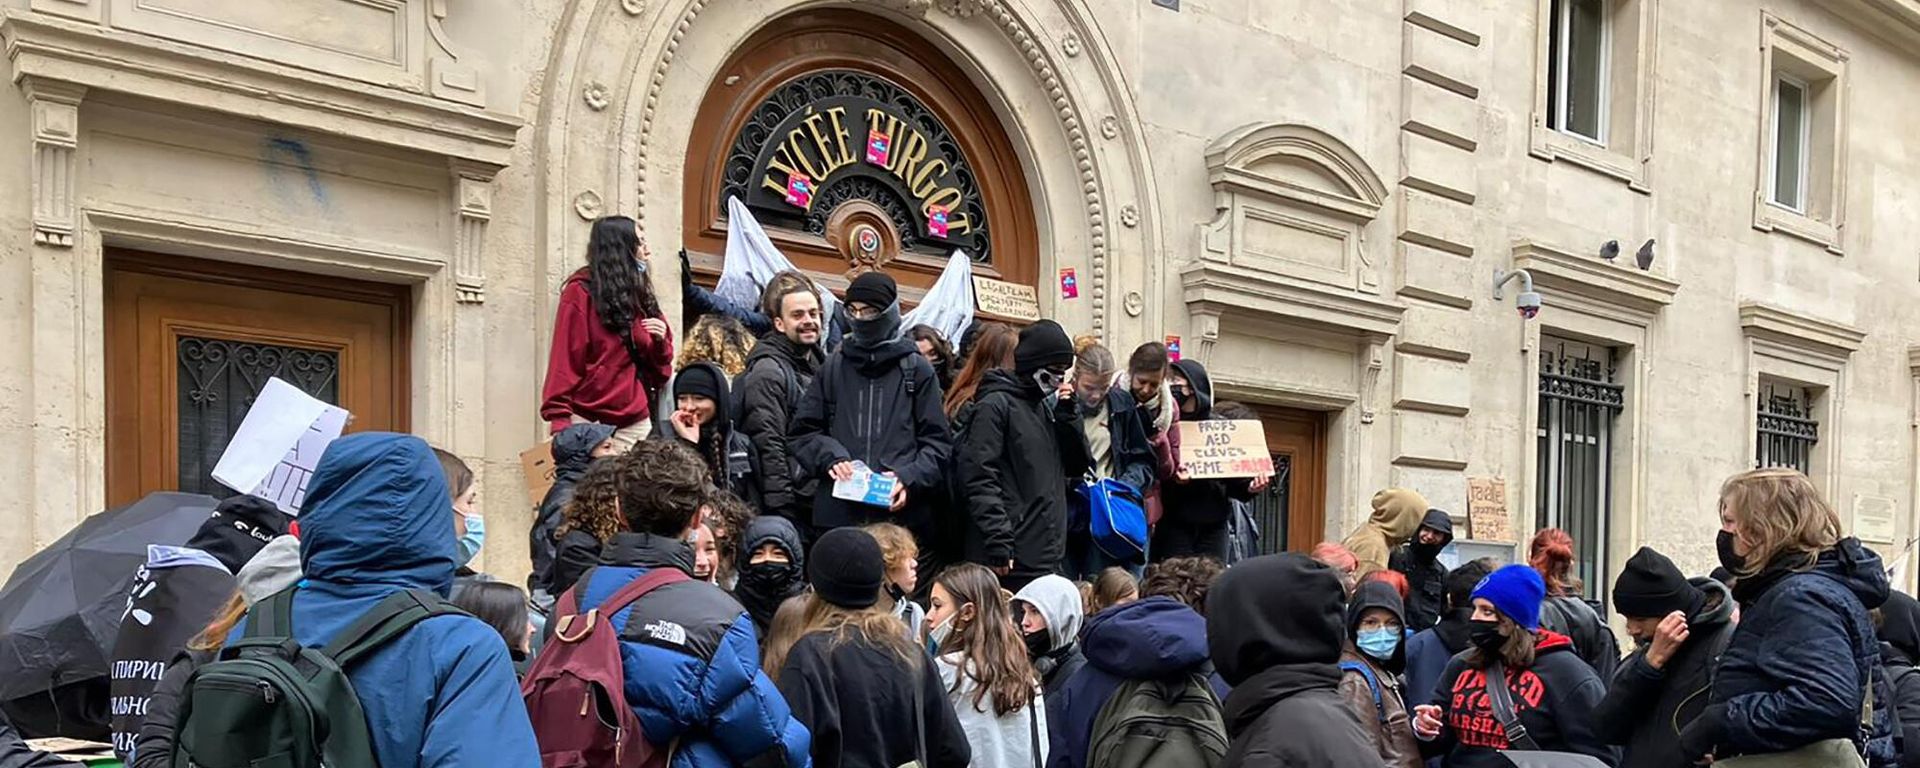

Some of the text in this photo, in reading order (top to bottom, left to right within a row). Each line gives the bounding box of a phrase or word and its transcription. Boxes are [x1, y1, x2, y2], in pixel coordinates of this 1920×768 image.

[761, 106, 971, 235] LYCÉE TURGOT
[1198, 421, 1236, 432] PROFS
[1206, 433, 1230, 446] AED
[644, 624, 671, 637] NORTH
[650, 629, 671, 641] FACE
